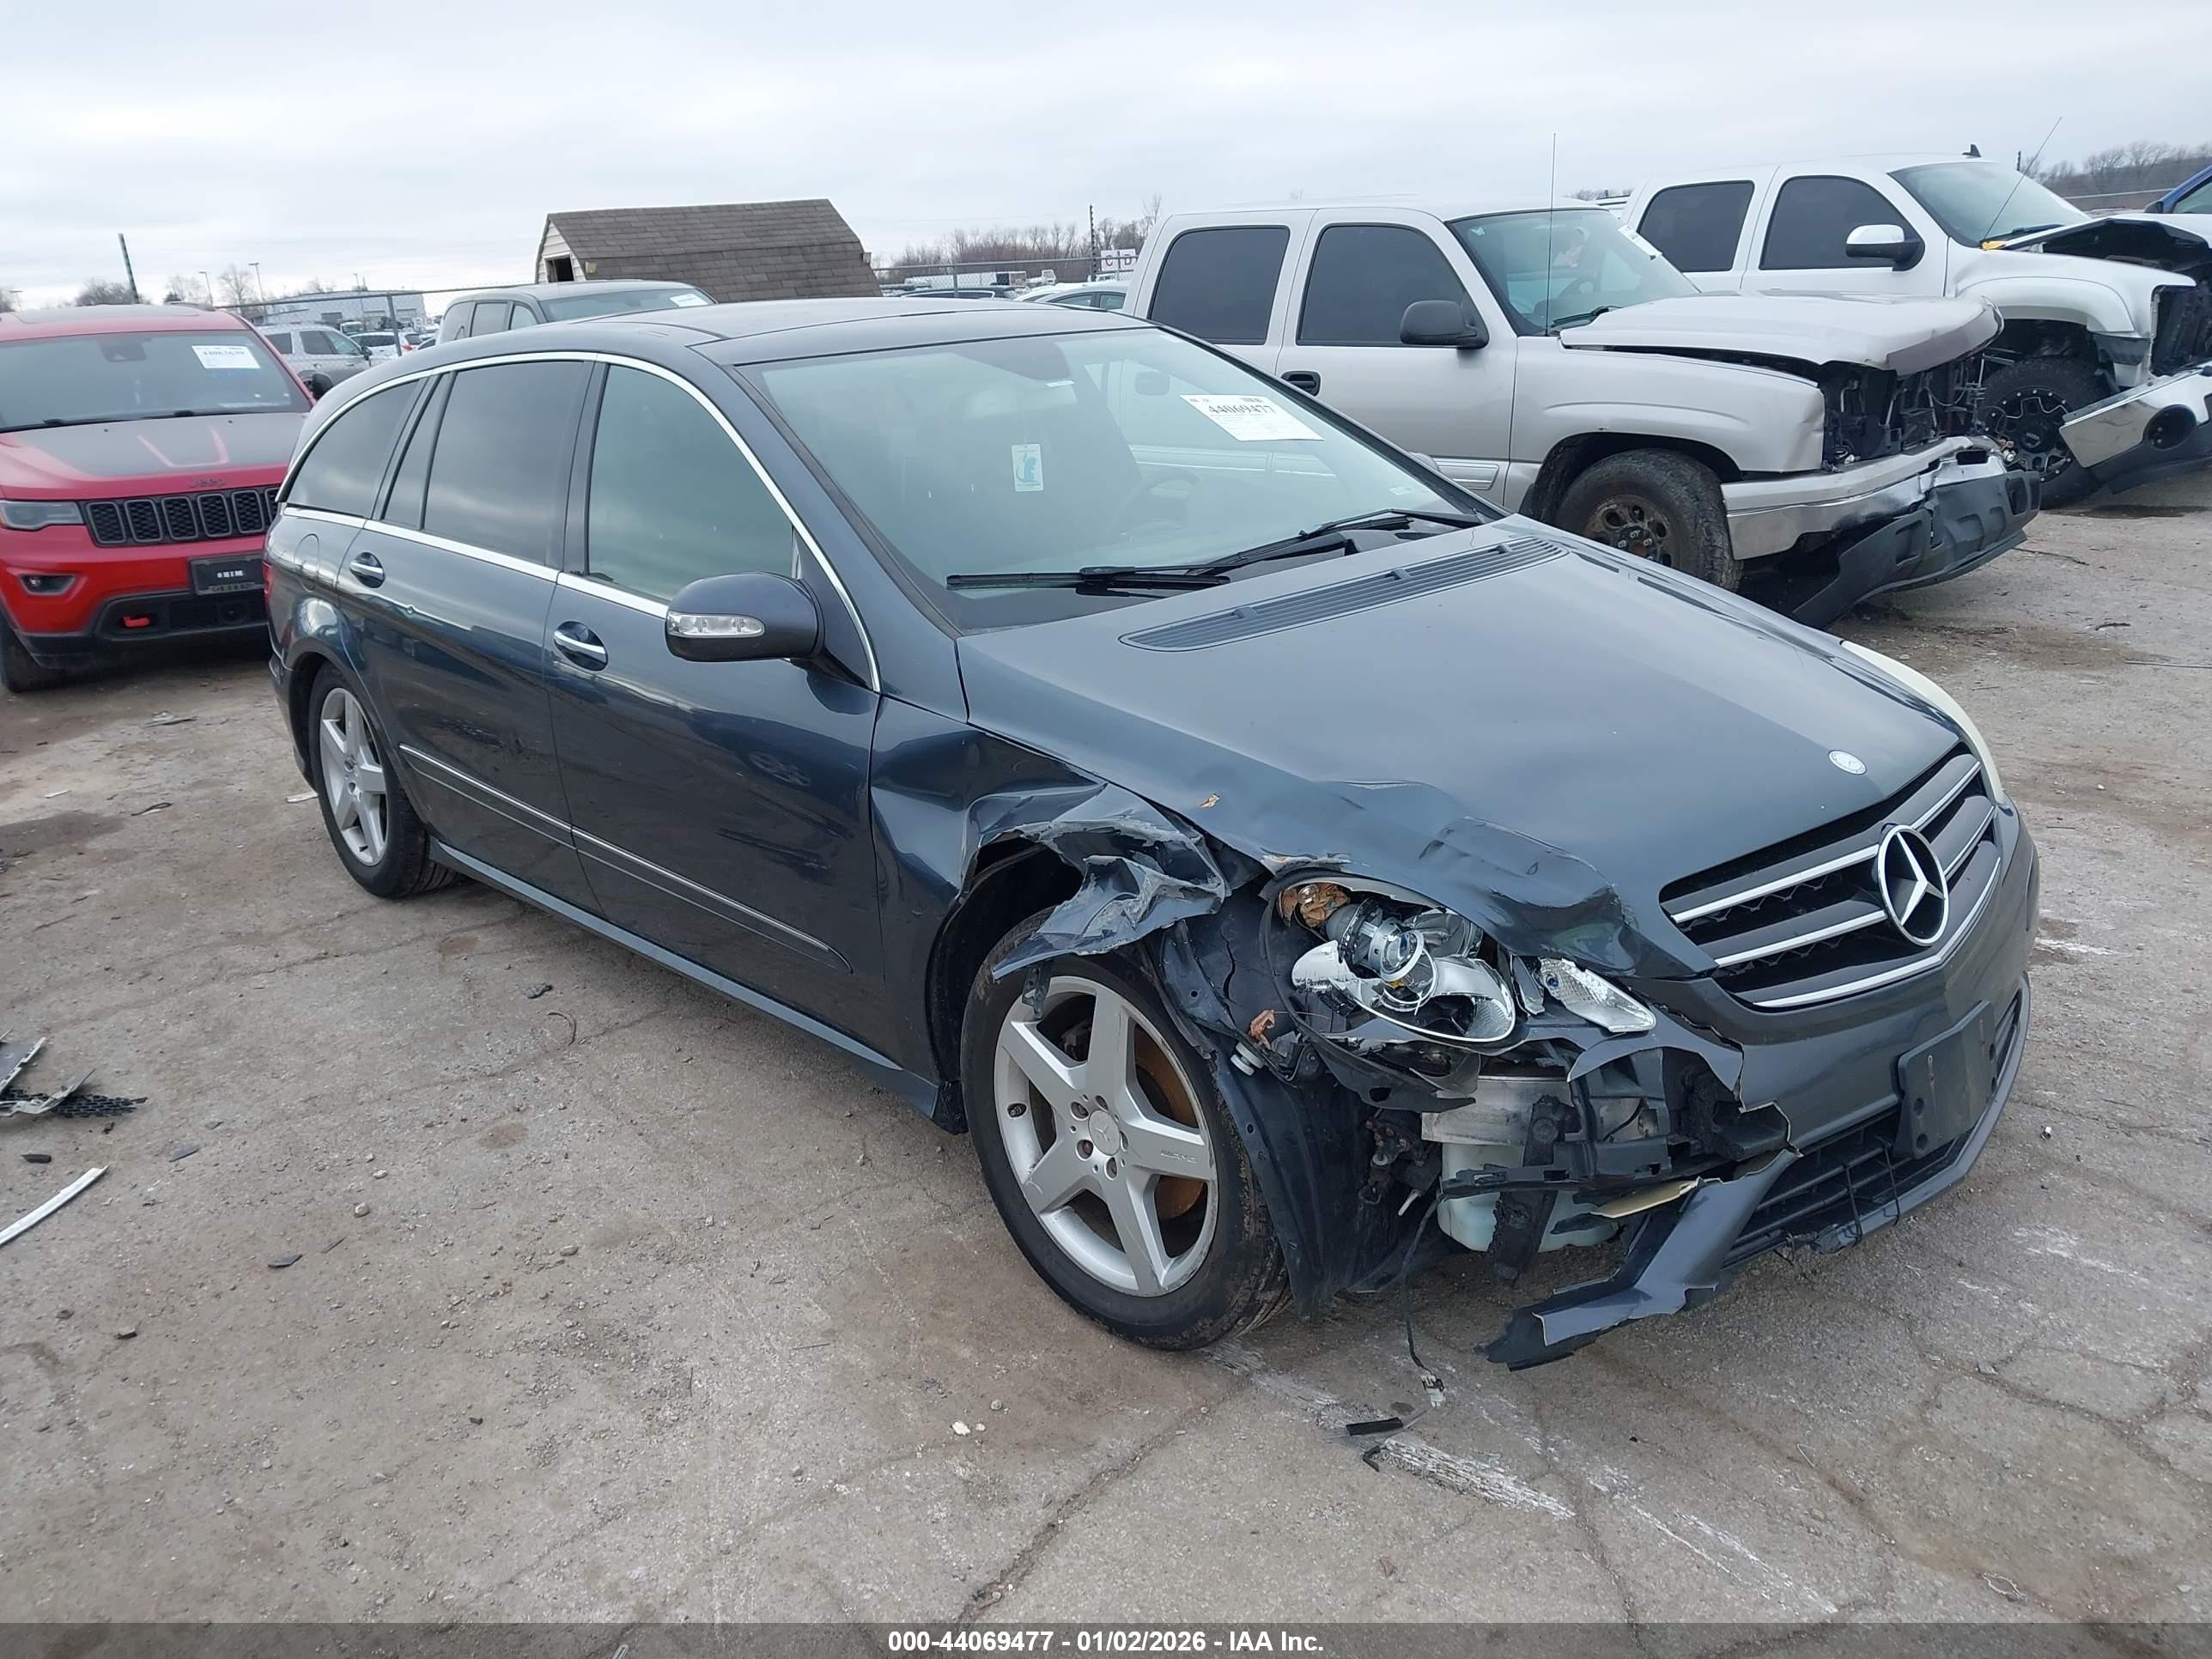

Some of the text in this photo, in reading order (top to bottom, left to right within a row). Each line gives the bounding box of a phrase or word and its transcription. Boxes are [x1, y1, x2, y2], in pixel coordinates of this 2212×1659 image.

[1105, 254, 1114, 266] C
[1124, 253, 1133, 265] D
[1208, 404, 1277, 414] 44069477
